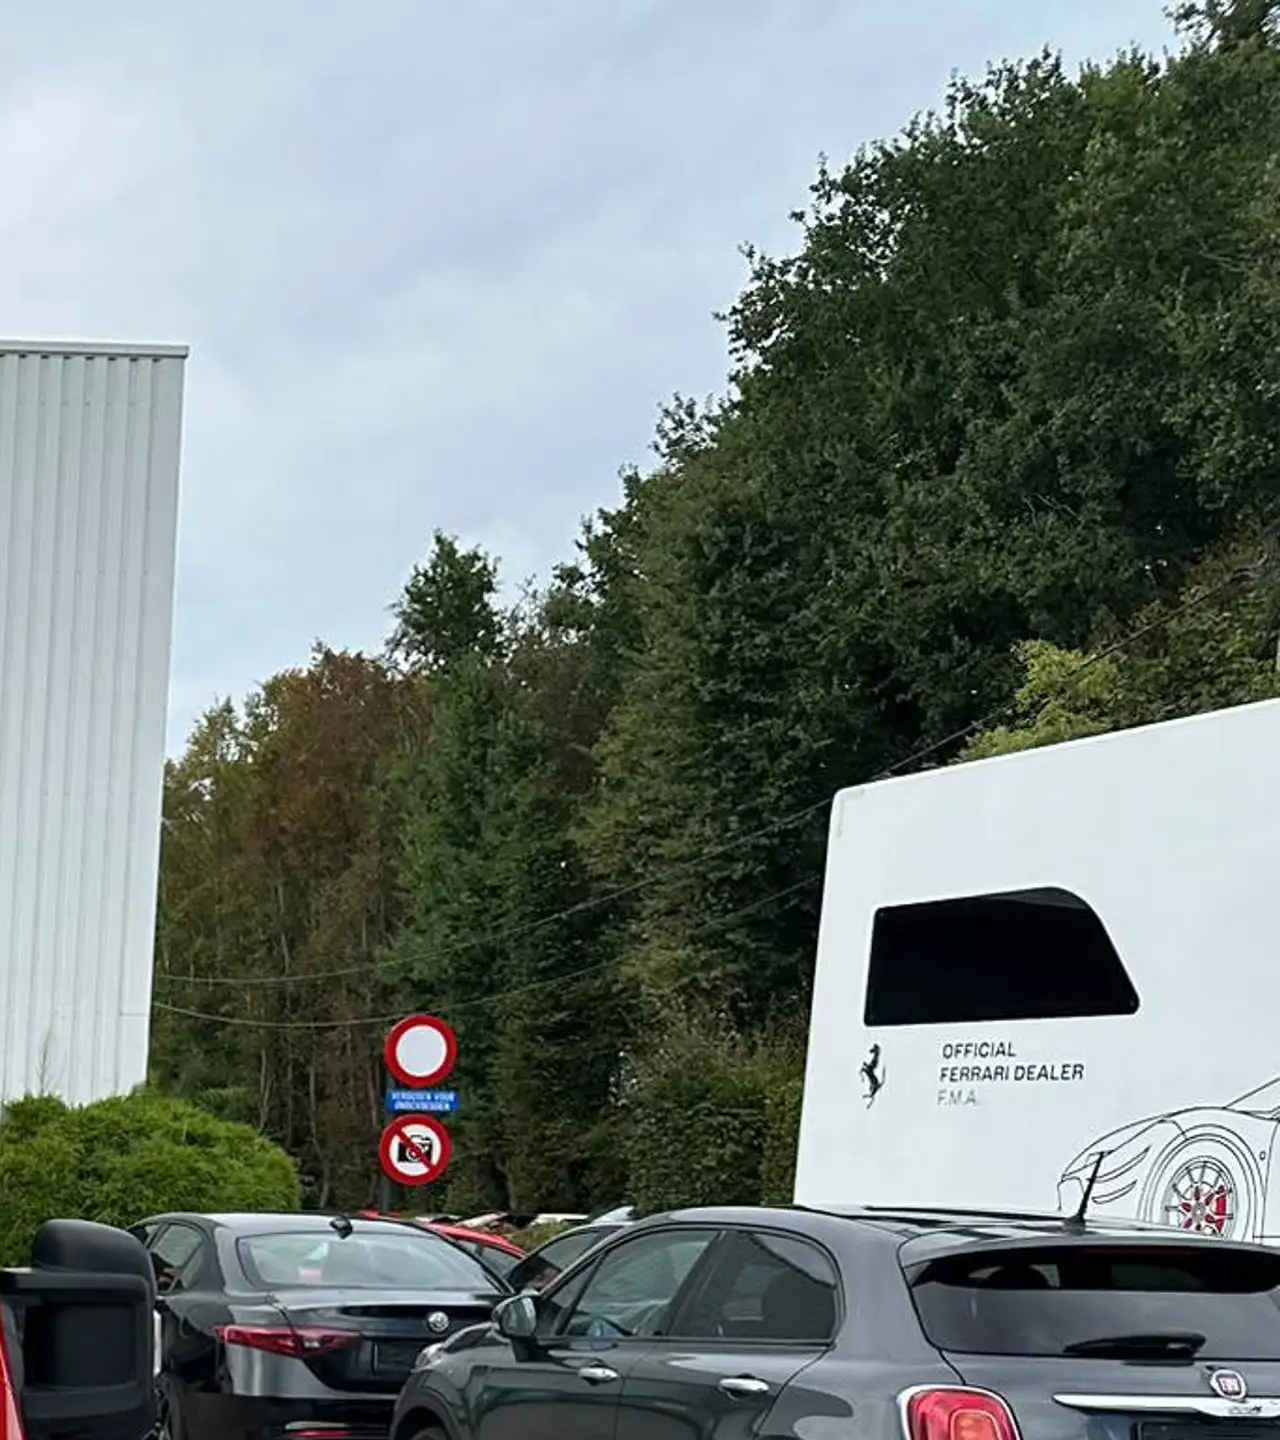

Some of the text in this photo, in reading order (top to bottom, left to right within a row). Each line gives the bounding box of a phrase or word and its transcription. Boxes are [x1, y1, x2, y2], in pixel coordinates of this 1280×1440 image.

[942, 1041, 1017, 1059] OFFICIAL
[939, 1063, 1085, 1082] FERRARI DEALER
